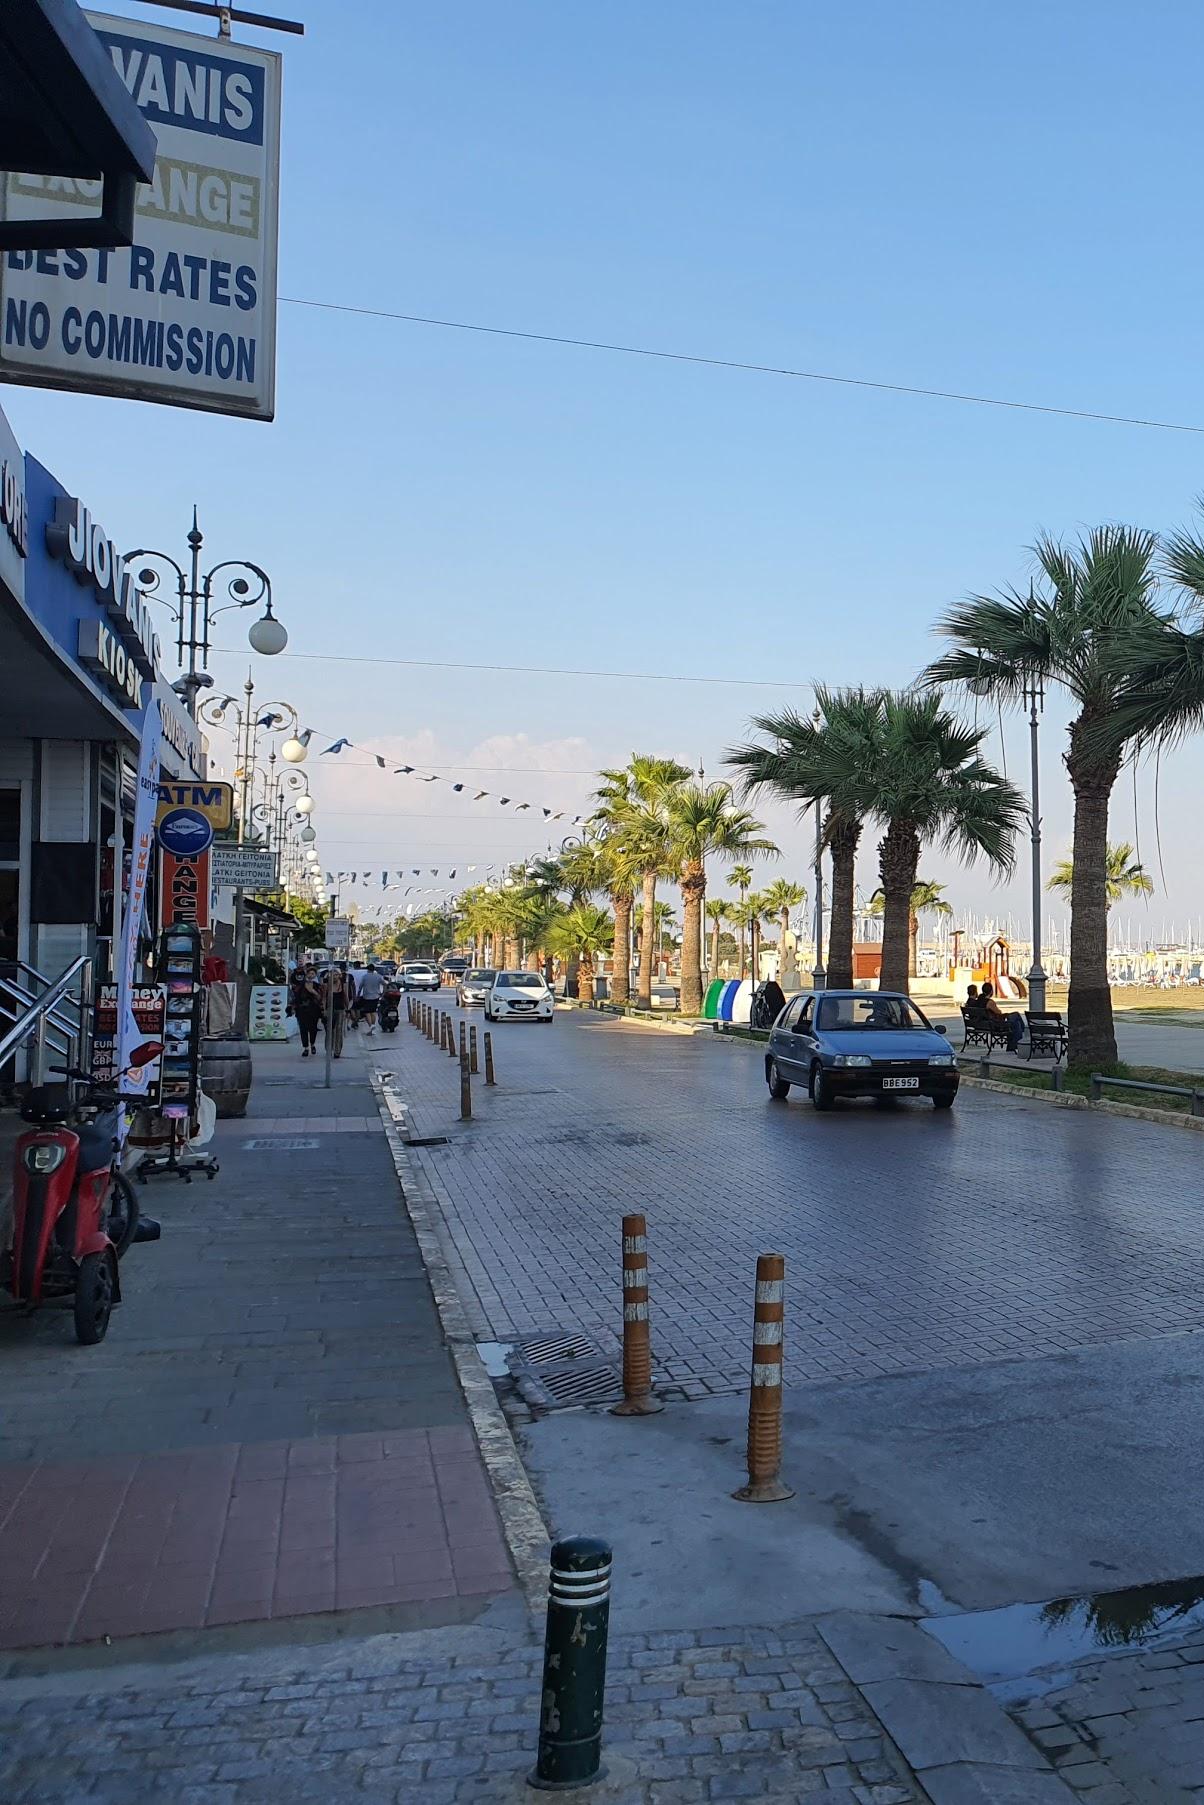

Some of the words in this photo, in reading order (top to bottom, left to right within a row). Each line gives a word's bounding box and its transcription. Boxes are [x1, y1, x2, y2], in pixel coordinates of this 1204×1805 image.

[109, 46, 254, 131] VANIS
[130, 245, 257, 311] RATES
[5, 298, 51, 350] NO
[62, 307, 257, 383] COMMISSION
[2, 459, 28, 557] ORE
[66, 498, 161, 682] JIOVANIS
[97, 620, 143, 710] KIOSK
[158, 785, 222, 806] ATM
[212, 877, 271, 886] ESTAURANTS-PUBS
[99, 1000, 162, 1011] Exange
[101, 986, 163, 1001] Mney
[92, 1057, 112, 1065] GBP
[94, 1041, 113, 1049] EUR
